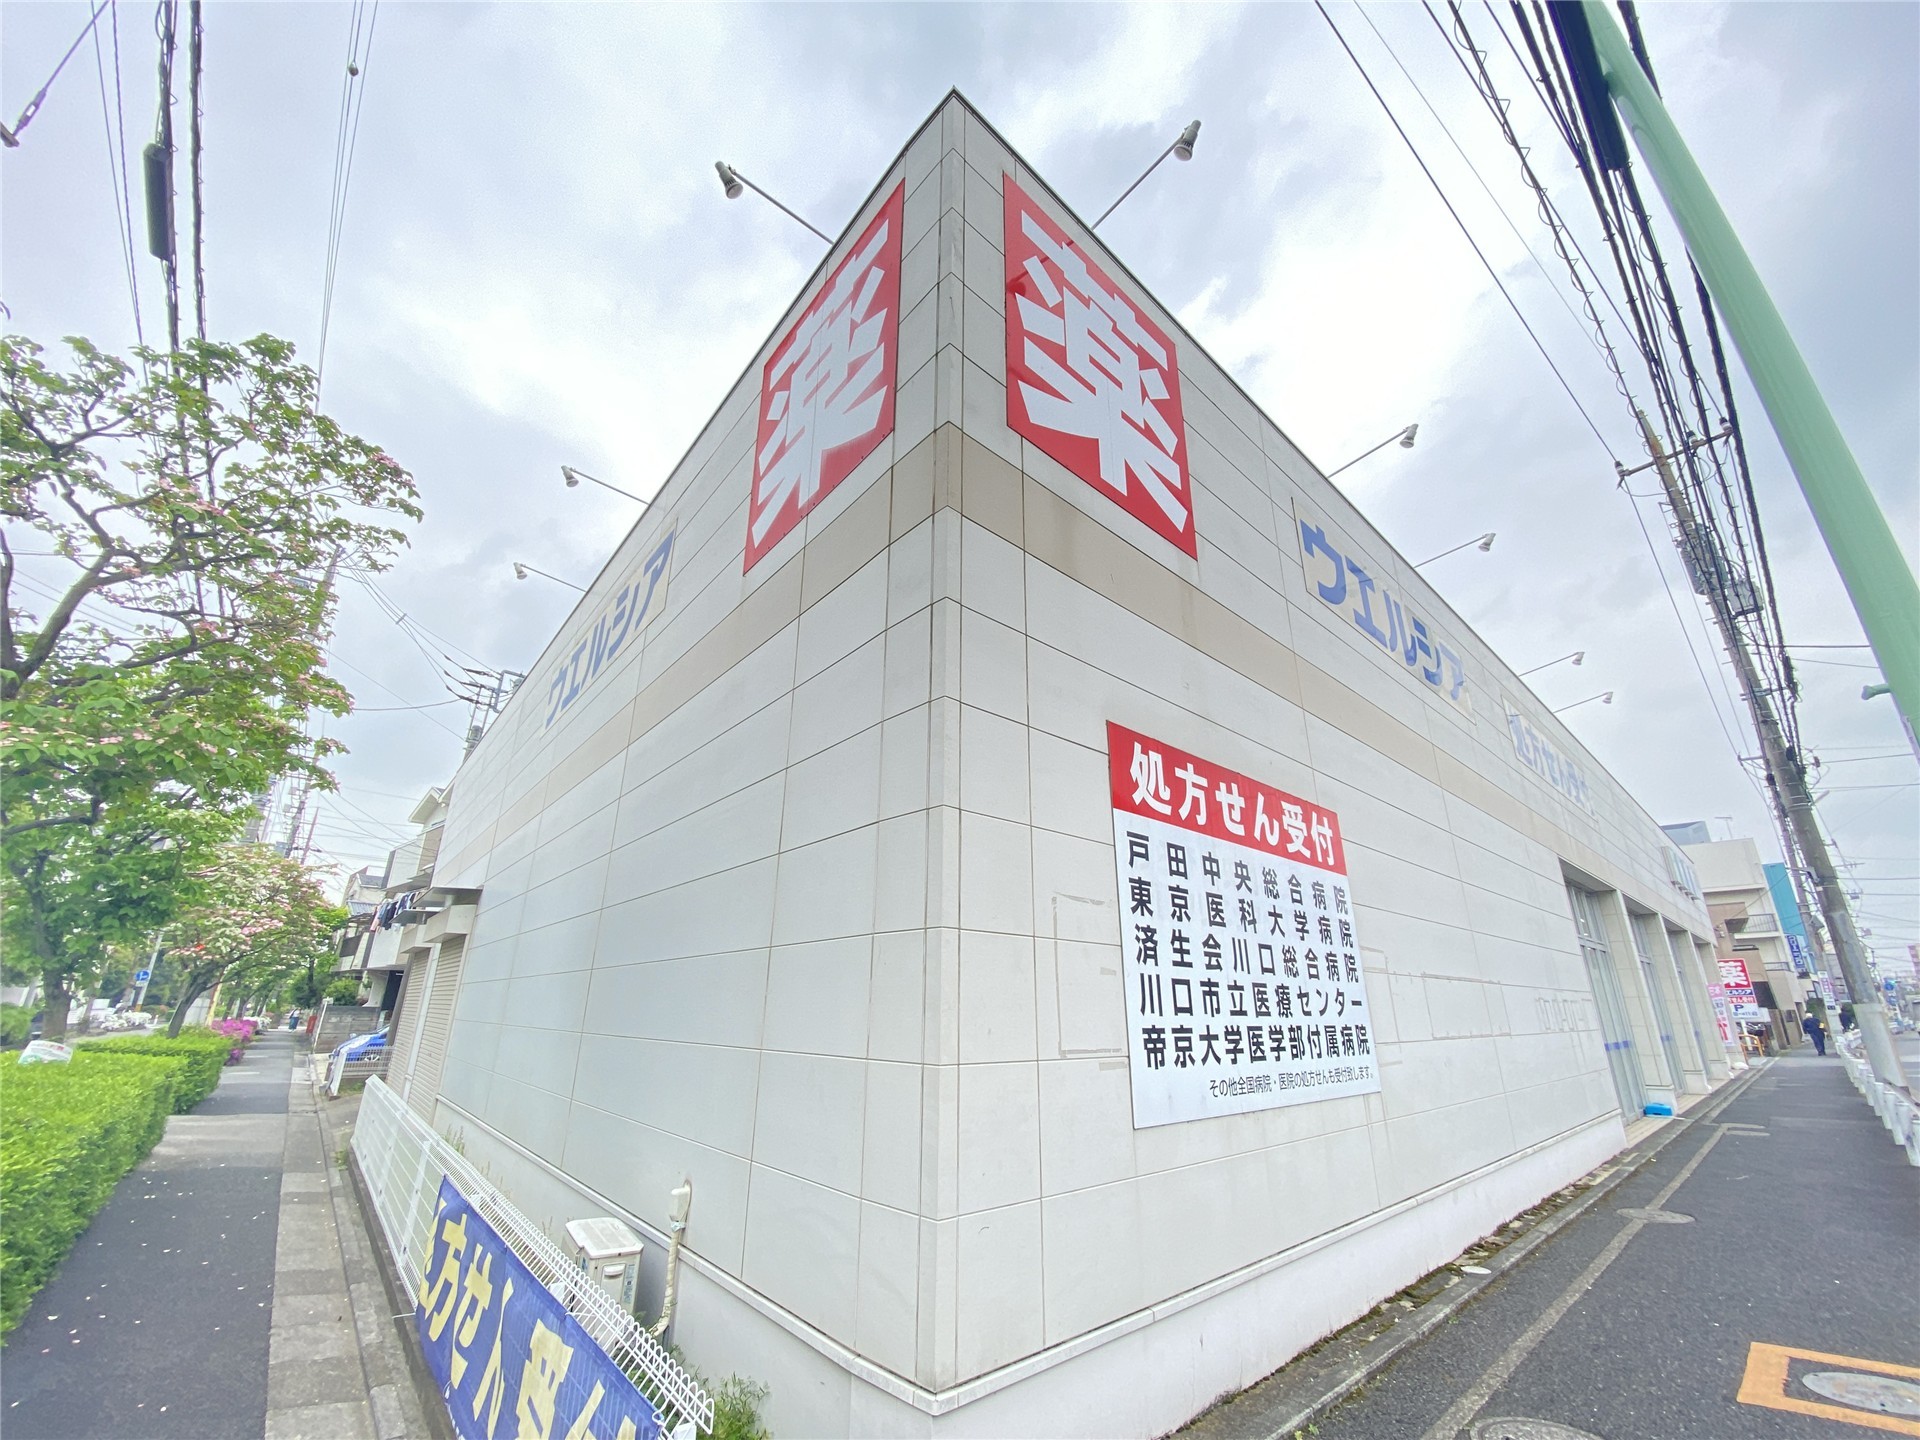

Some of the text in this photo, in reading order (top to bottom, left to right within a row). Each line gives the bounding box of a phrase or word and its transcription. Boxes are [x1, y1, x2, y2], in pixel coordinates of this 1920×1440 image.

[751, 218, 889, 549] 薬
[1015, 209, 1188, 534] 薬
[546, 528, 675, 729] ウエルシア
[1130, 741, 1335, 867] 処方せん受付
[1126, 830, 1348, 916] 戸田中央総合病院
[1128, 876, 1354, 949] 東京医科大学病院
[1135, 923, 1358, 984] 済生会川口総合病院
[1140, 973, 1362, 1018] 川口市立医療センター
[1143, 1024, 1370, 1070] 帝京大学医学部付属病院
